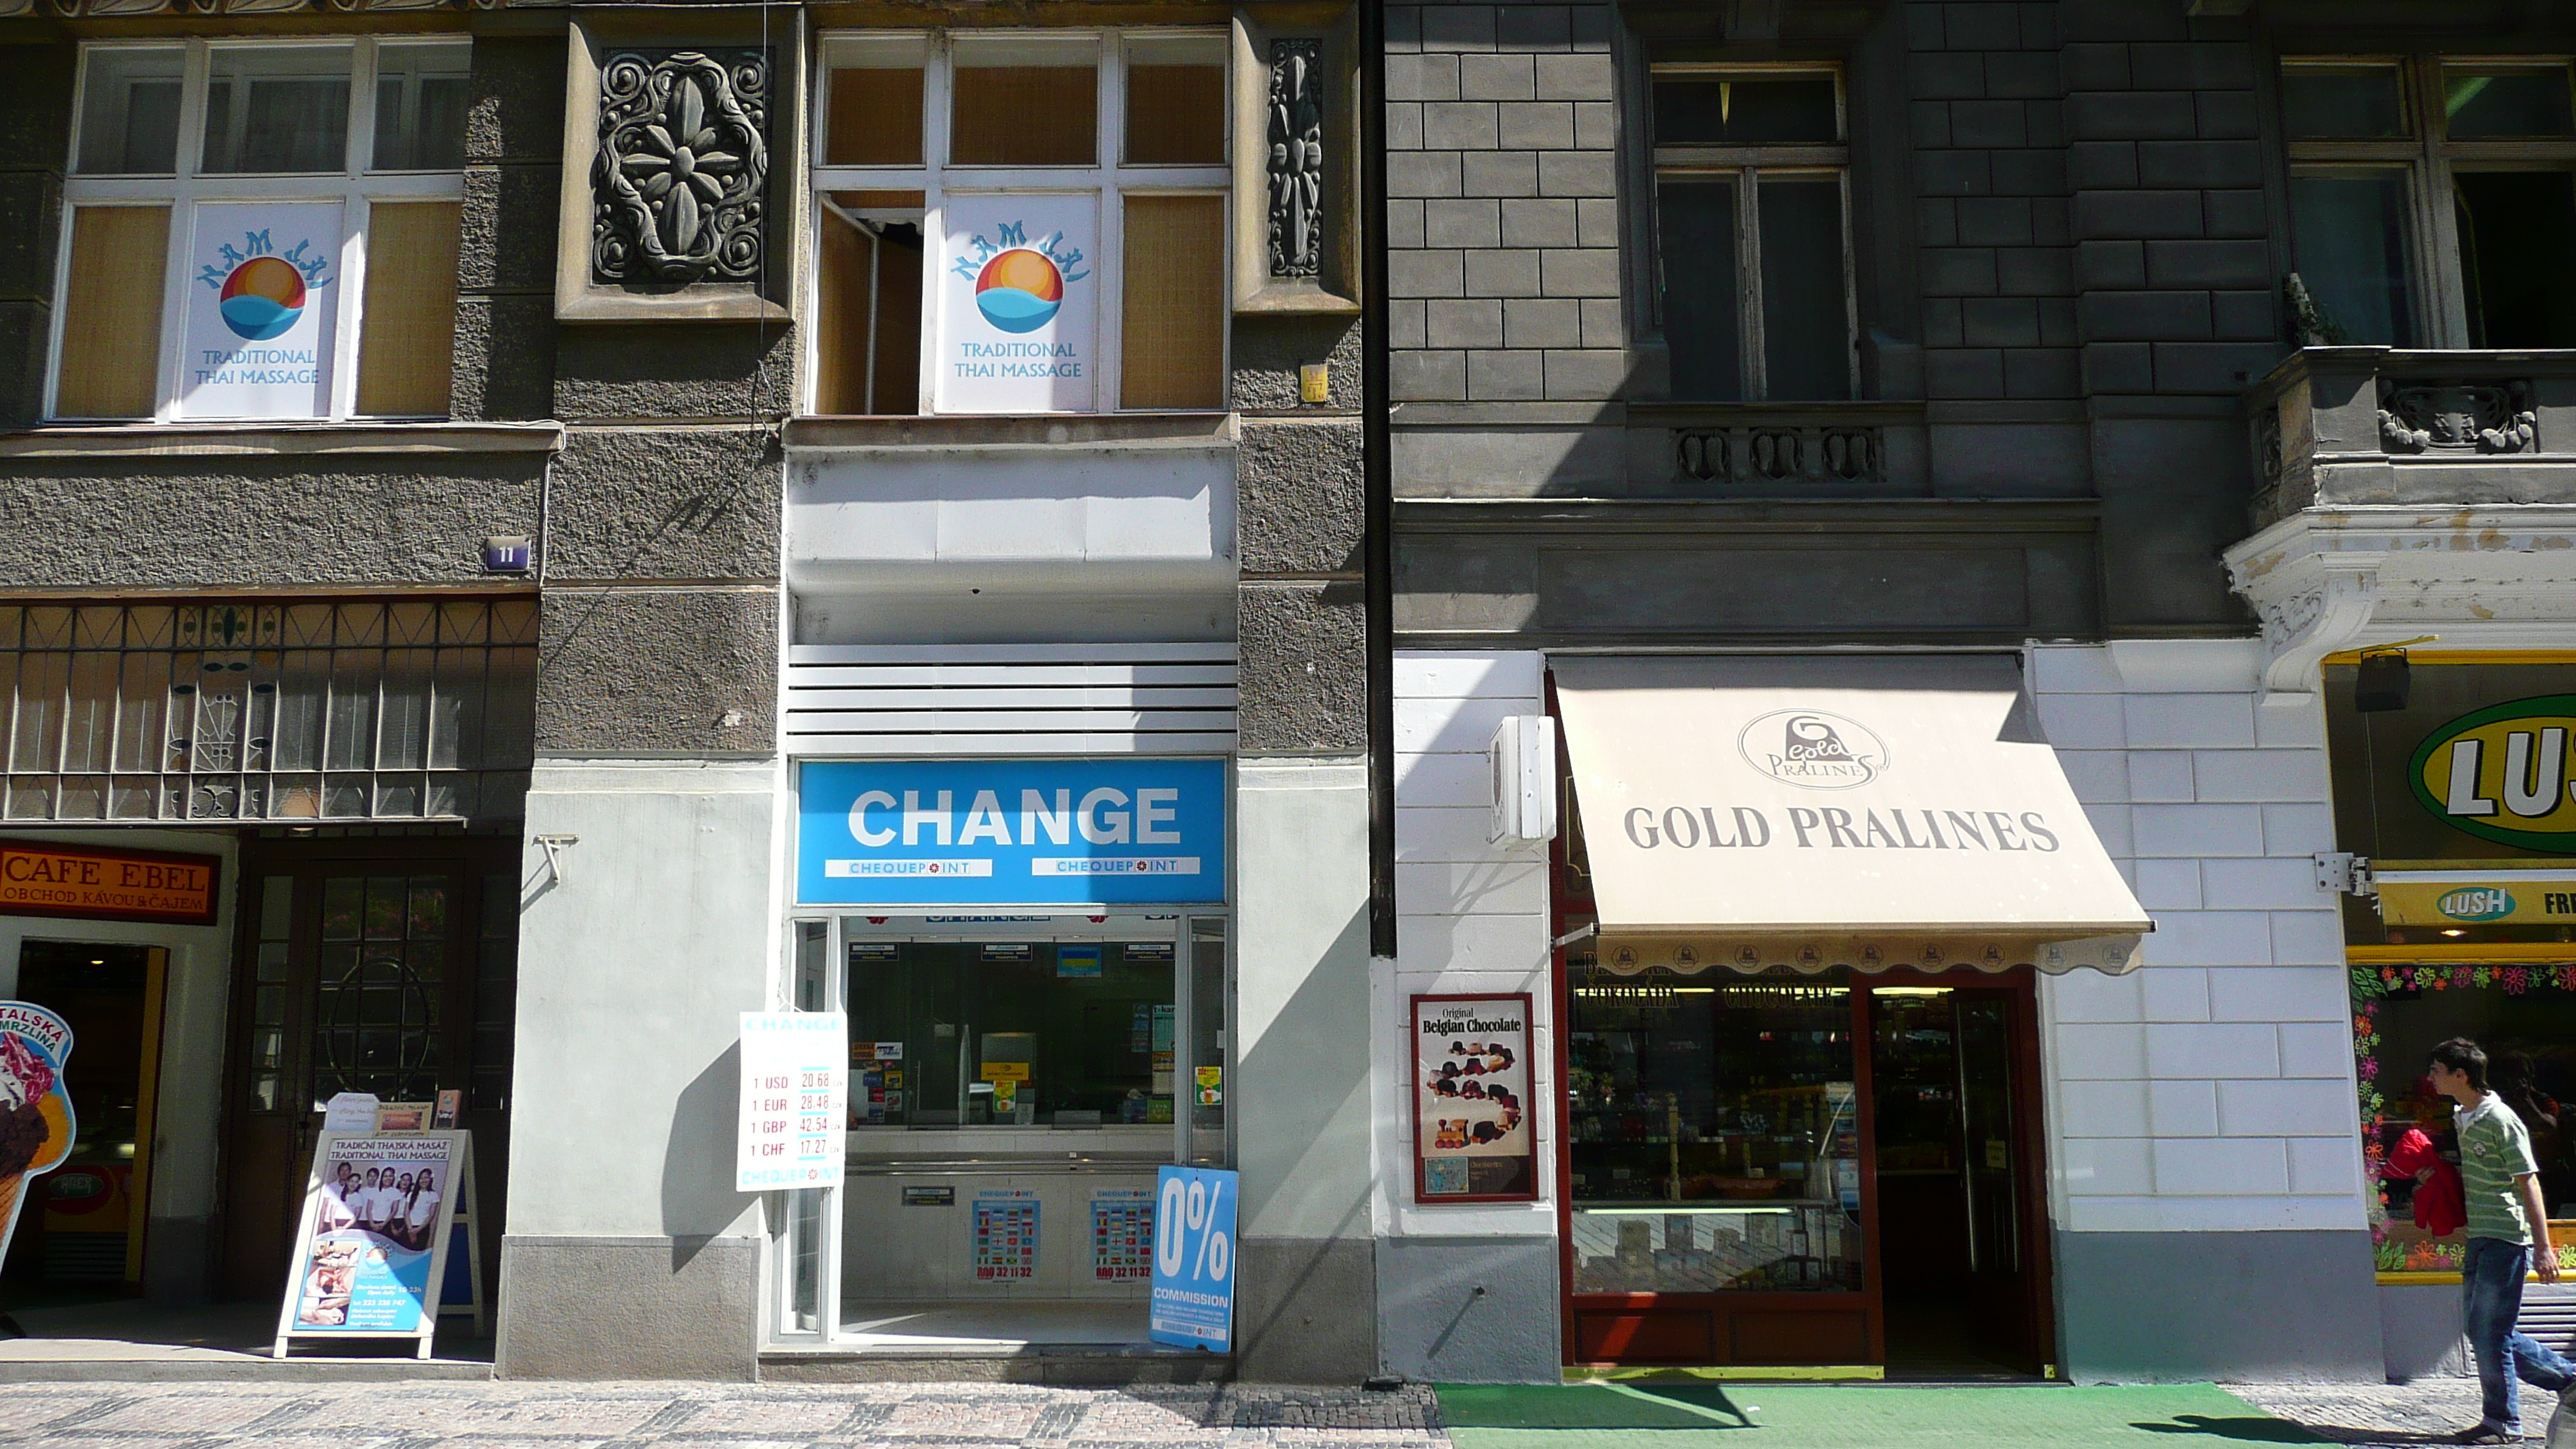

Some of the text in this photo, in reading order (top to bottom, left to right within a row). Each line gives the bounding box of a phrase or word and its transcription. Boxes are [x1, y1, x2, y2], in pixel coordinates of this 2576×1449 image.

[203, 350, 316, 364] TRADITIONAL
[961, 342, 1076, 357] TRADITIONAL
[195, 369, 320, 384] THAI MASSAGE
[954, 363, 1082, 377] THAI MASSAGE
[499, 546, 514, 563] 11
[1766, 752, 1879, 788] PRALINES
[2448, 726, 2576, 817] LU
[848, 786, 1181, 847] CHANGE
[1625, 807, 2059, 852] GOLD PRALINES
[5, 855, 206, 892] CAFE EBEL
[4, 887, 77, 903] OBCHOD
[83, 889, 135, 906] KÁVOU
[149, 893, 204, 910] ČAJEM
[2444, 889, 2506, 914] LUSH
[1443, 1008, 1474, 1020] Original
[745, 1018, 842, 1030] CHANGE
[1423, 1018, 1521, 1036] Belgian Chocolate
[754, 1078, 759, 1089] 1
[766, 1077, 788, 1089] USD
[753, 1101, 757, 1111] 1
[765, 1099, 787, 1111] EUR
[751, 1122, 755, 1133] 1
[763, 1121, 786, 1133] GBP
[378, 1141, 413, 1150] THAJSKÁ
[751, 1145, 755, 1156] 1
[762, 1143, 785, 1156] CHF
[1160, 1178, 1228, 1281] 0%
[997, 1266, 1007, 1277] 32
[1020, 1266, 1032, 1277] 32
[1115, 1266, 1127, 1277] 32
[1139, 1266, 1151, 1277] 32
[1154, 1287, 1228, 1308] COMMISSION
